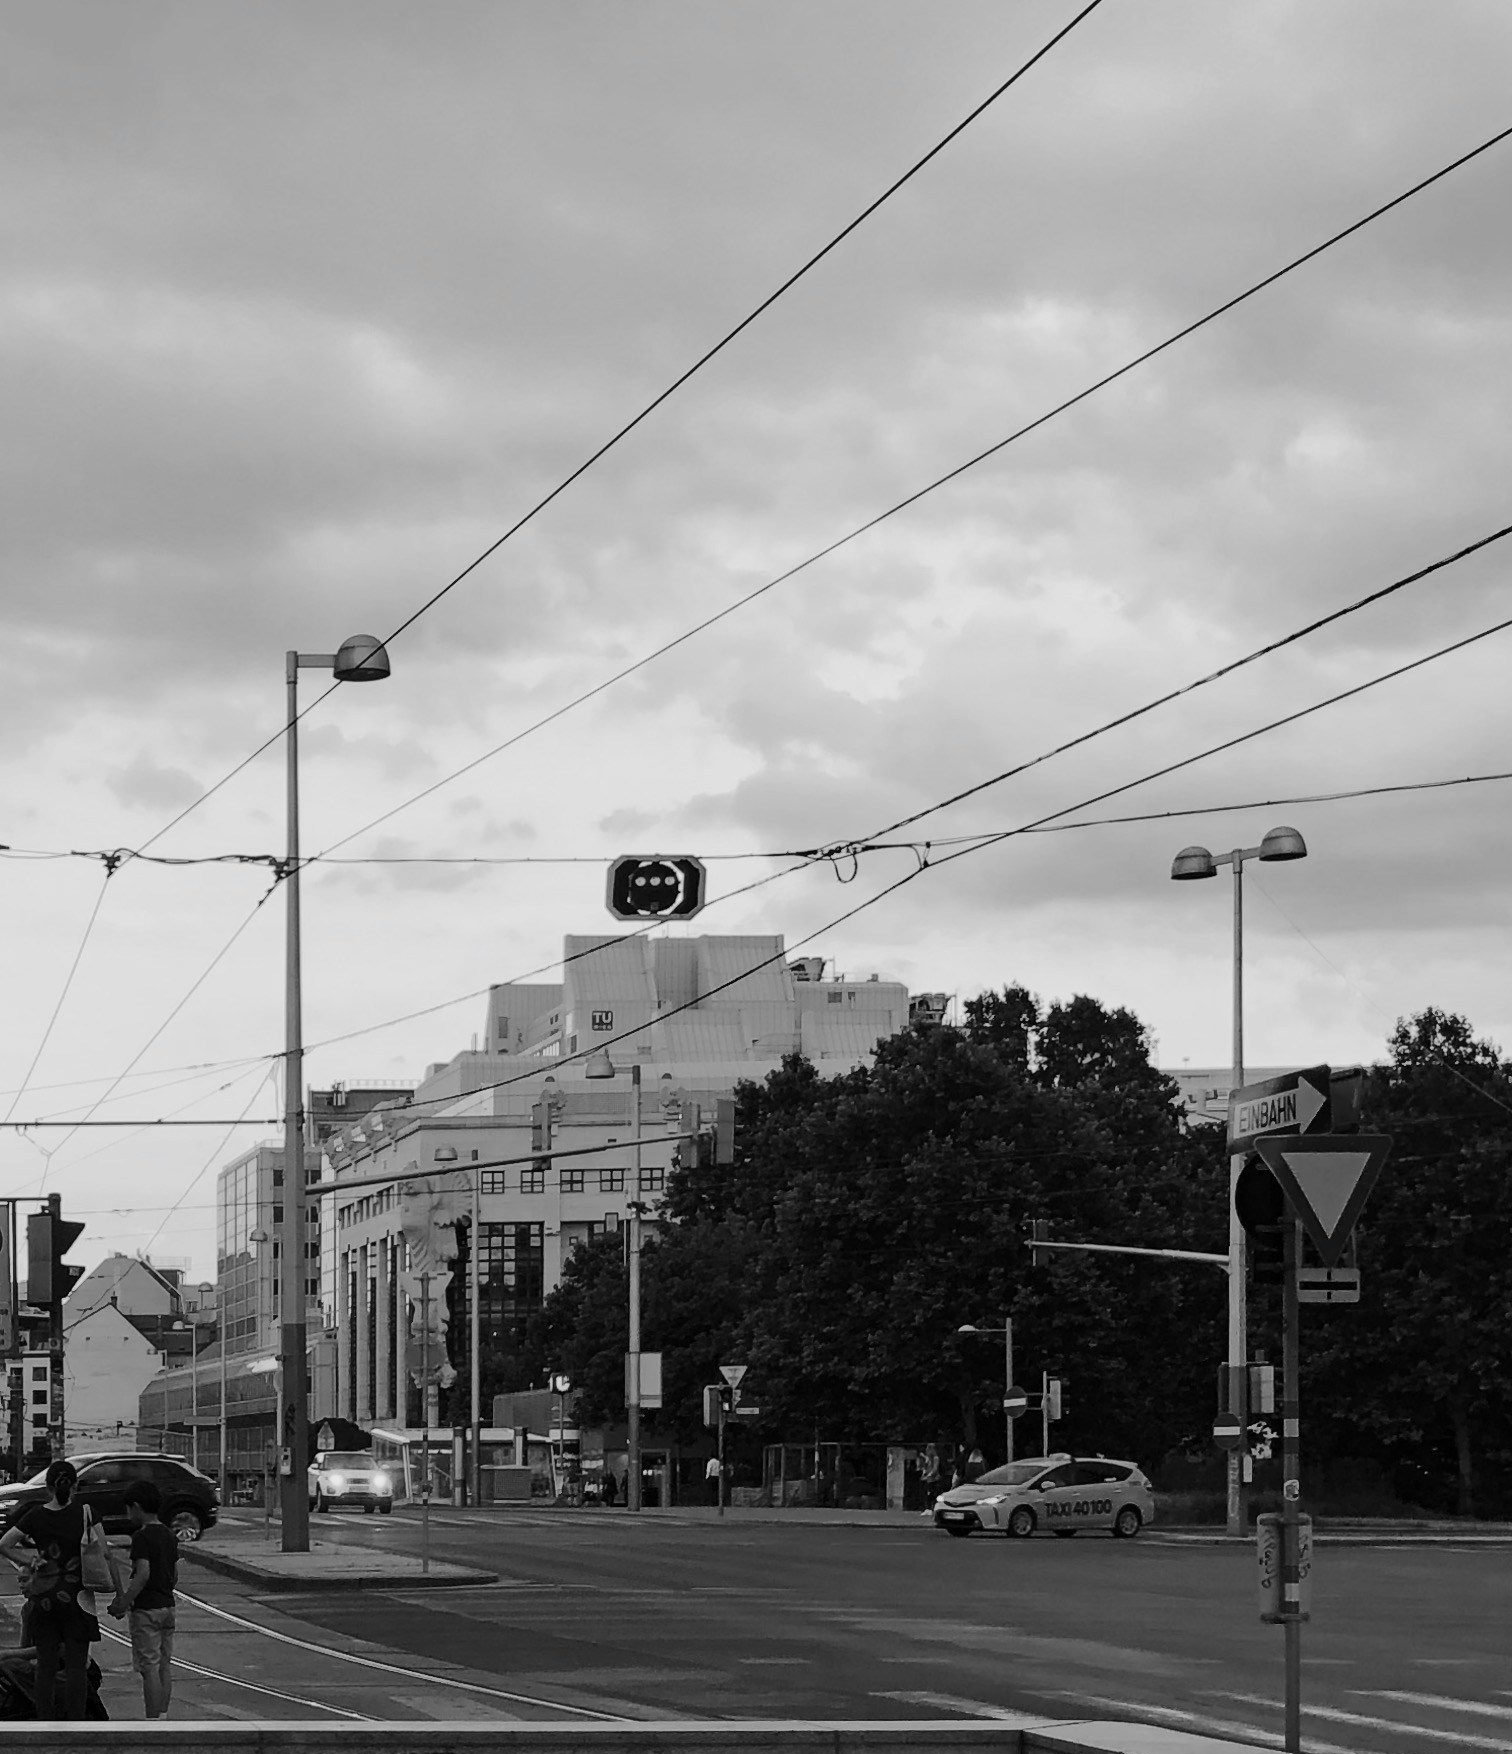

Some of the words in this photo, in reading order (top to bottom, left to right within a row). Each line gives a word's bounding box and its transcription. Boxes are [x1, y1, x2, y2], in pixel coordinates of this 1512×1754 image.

[593, 1012, 612, 1024] TU
[1239, 1093, 1297, 1133] EINBAHN
[1044, 1501, 1072, 1517] TAXI
[1073, 1499, 1112, 1515] 40100
